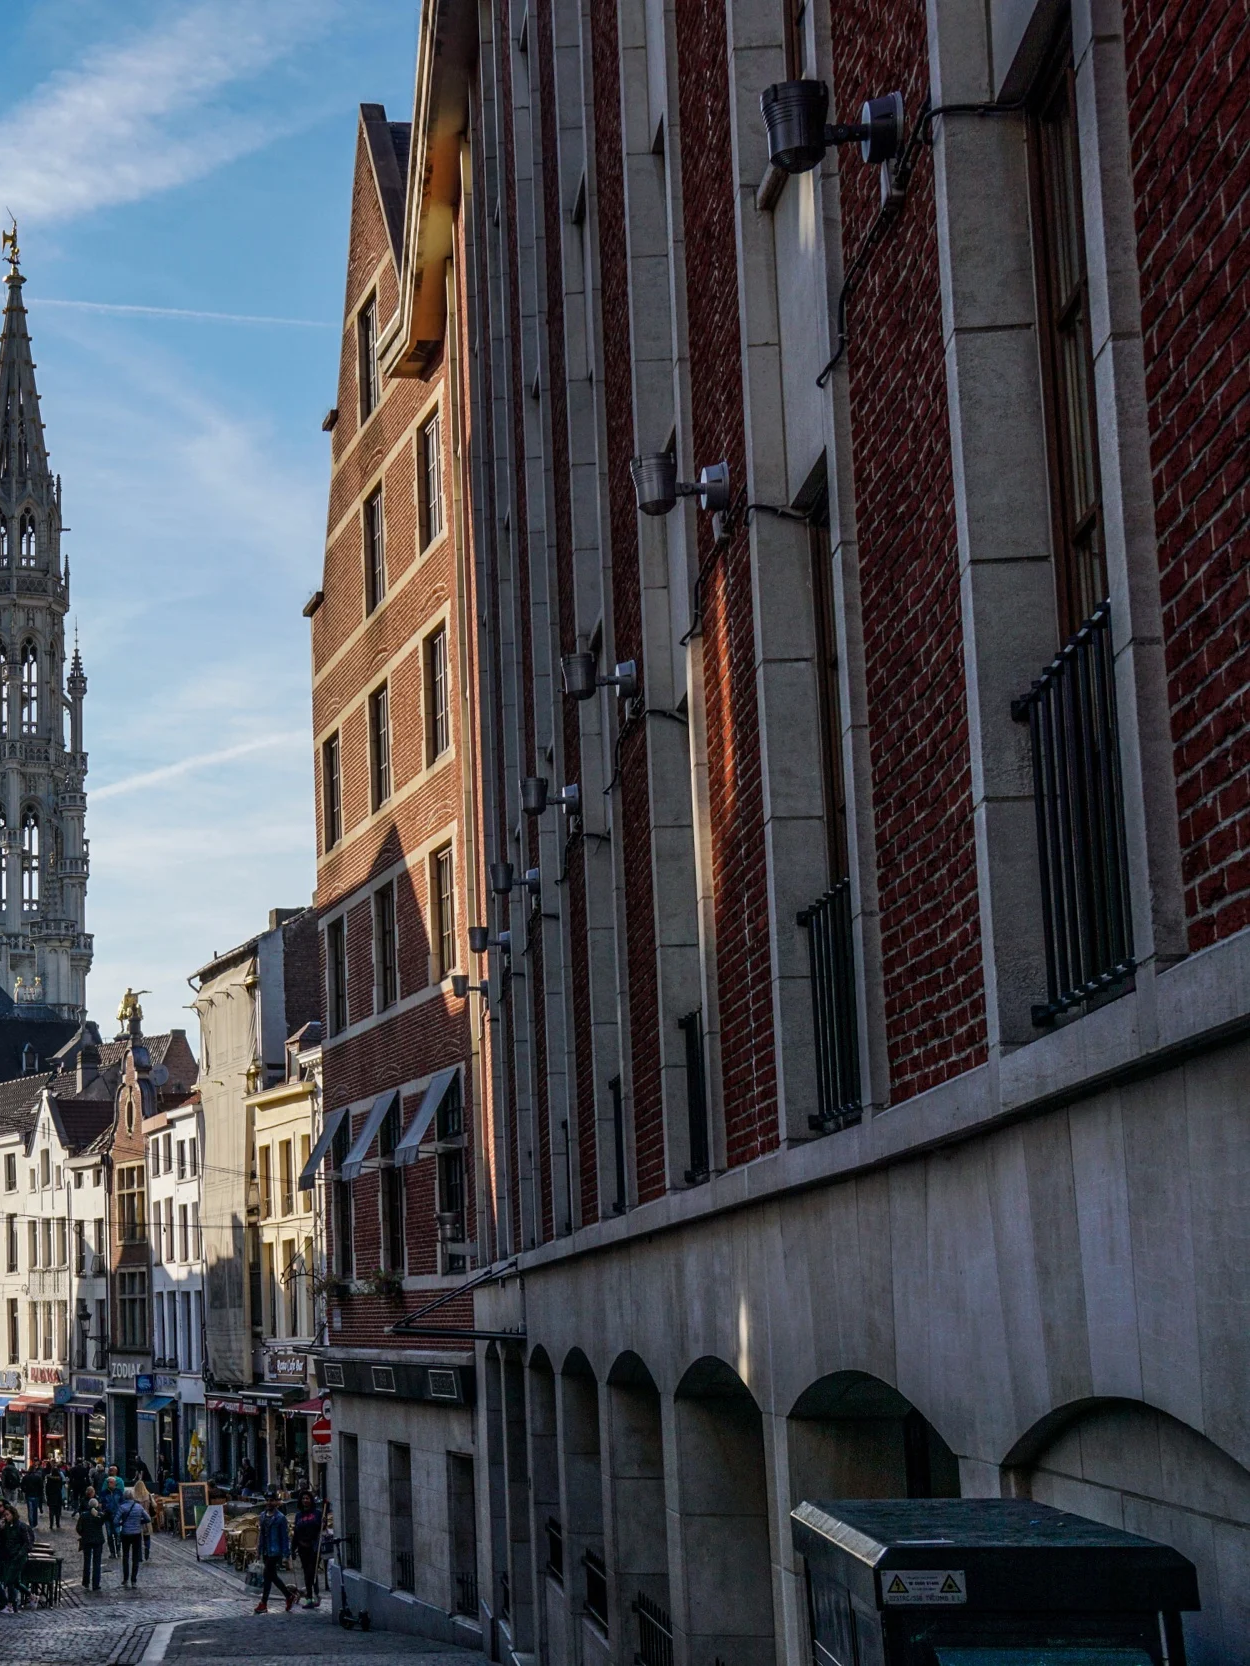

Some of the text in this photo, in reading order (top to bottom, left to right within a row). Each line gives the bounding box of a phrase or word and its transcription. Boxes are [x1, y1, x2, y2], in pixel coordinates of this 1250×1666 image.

[31, 1367, 61, 1383] PLAKA
[111, 1363, 141, 1378] ZODIAK
[198, 1509, 219, 1547] Giannino
